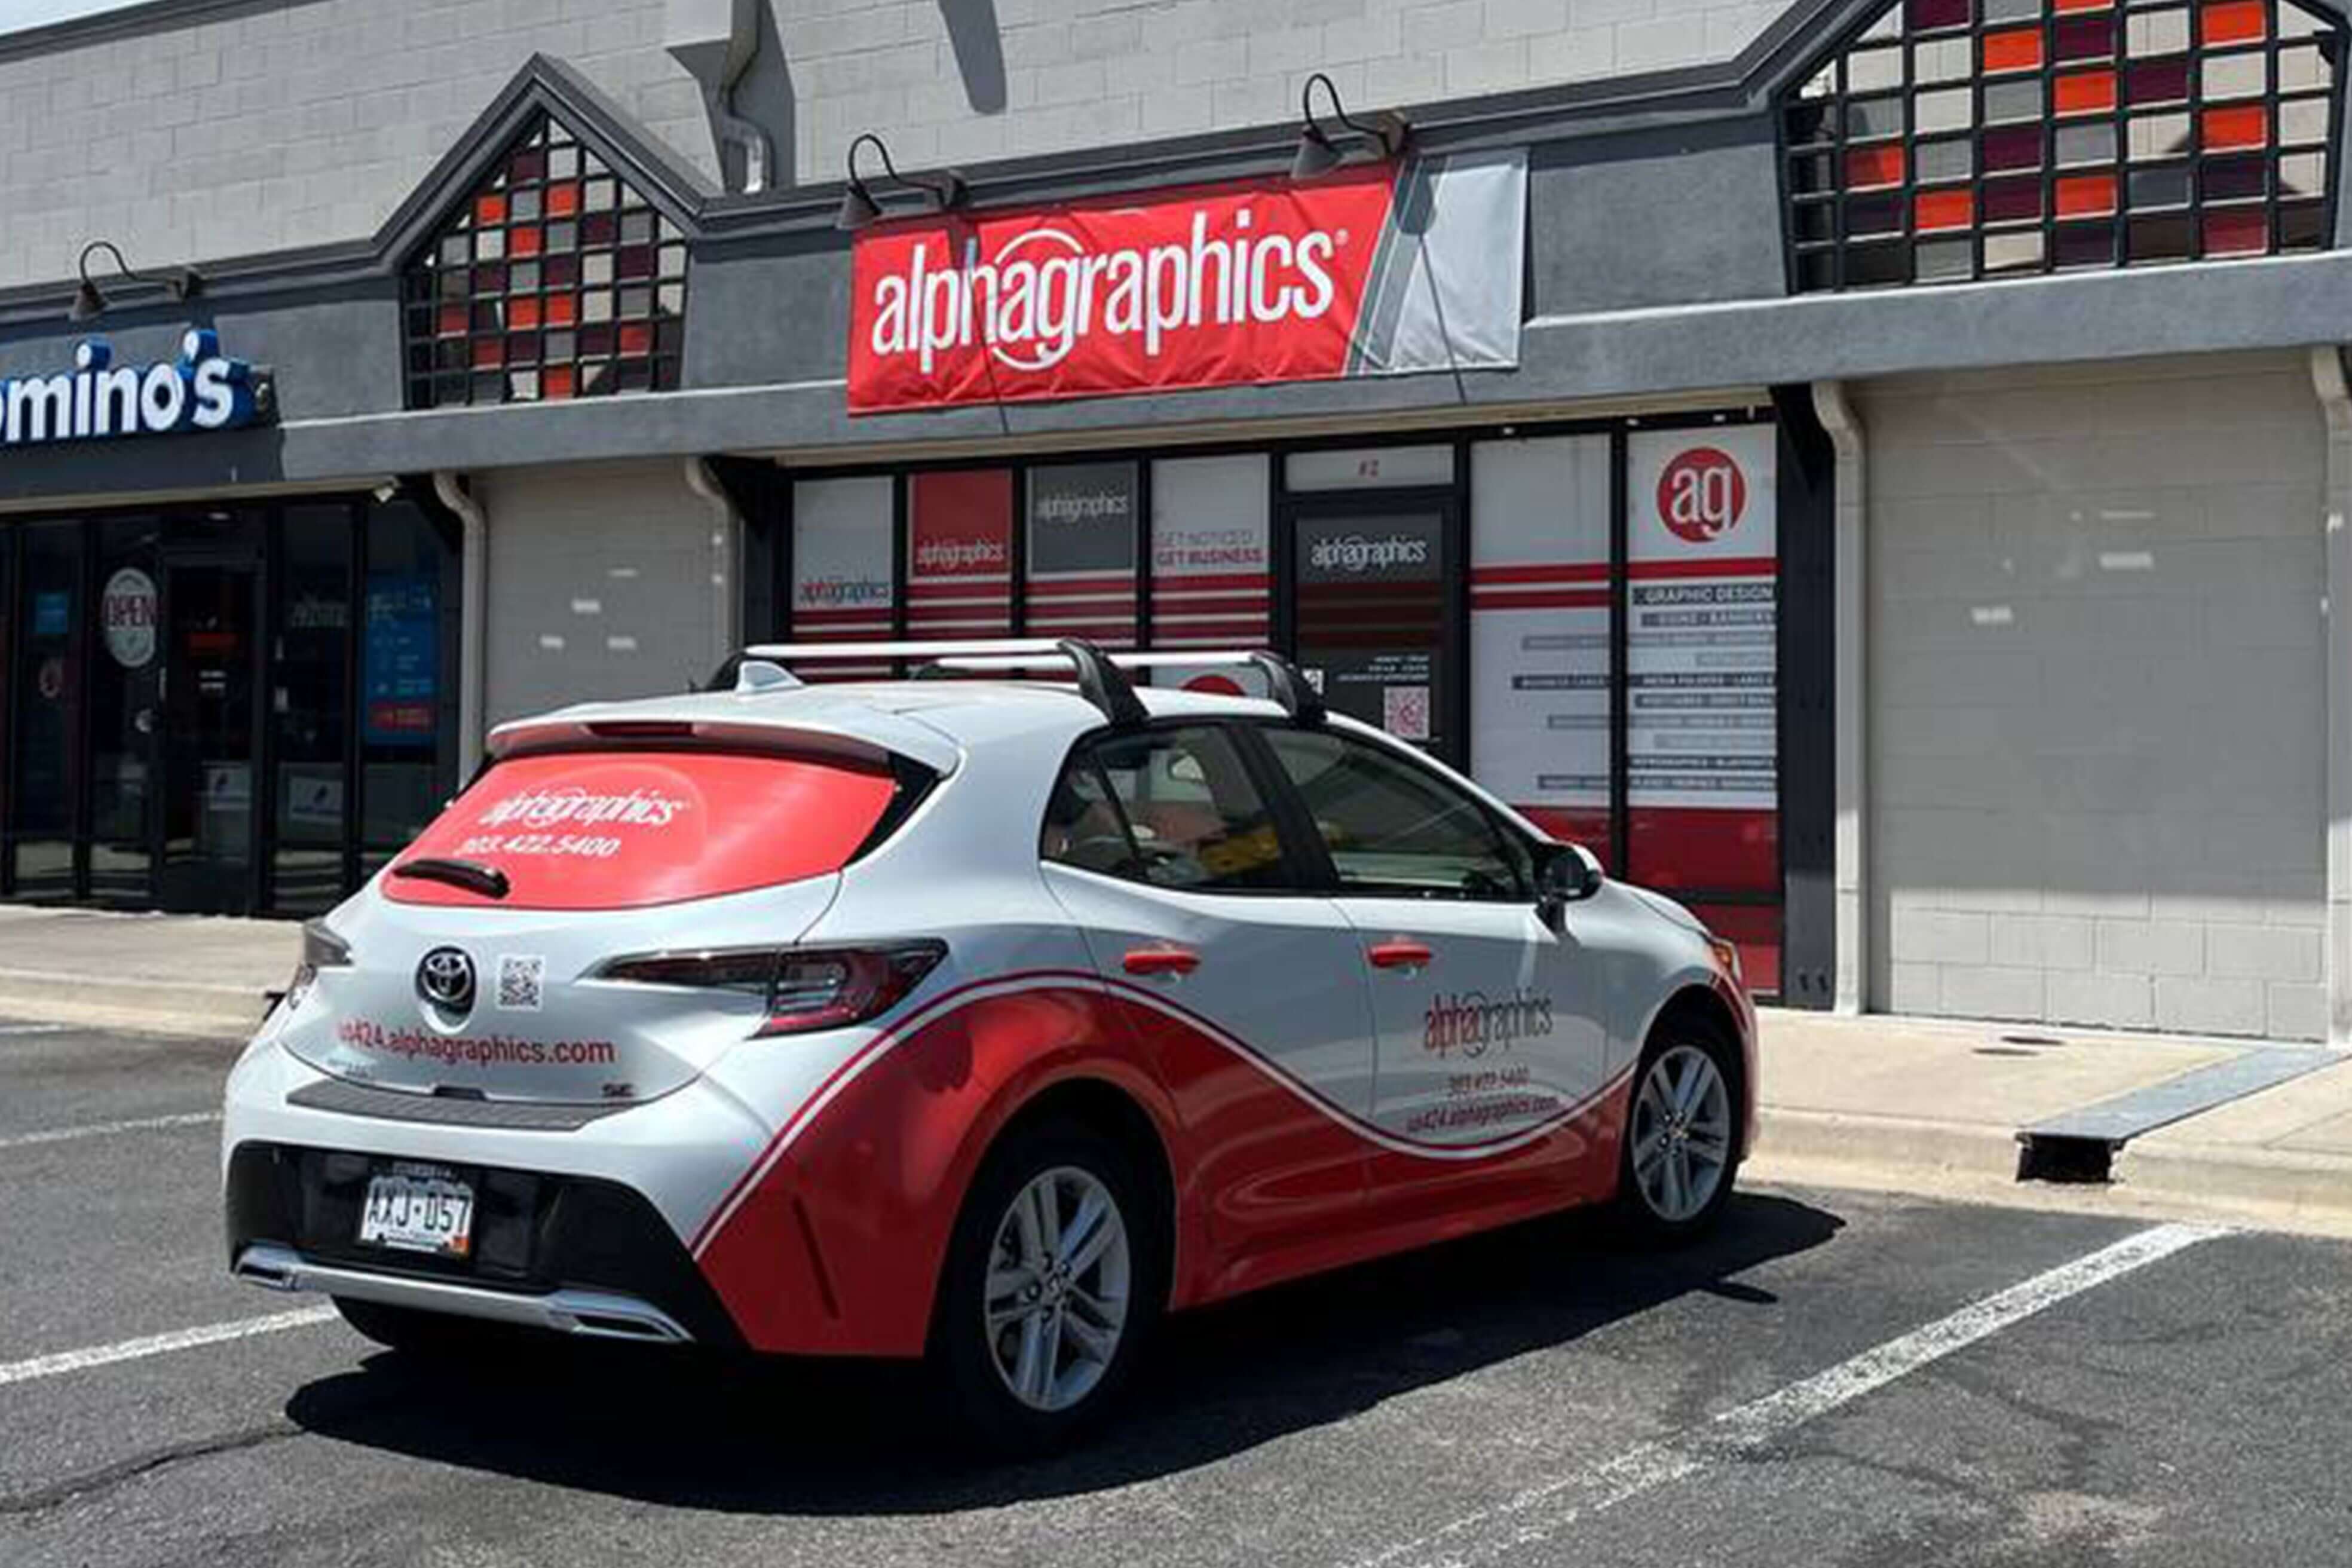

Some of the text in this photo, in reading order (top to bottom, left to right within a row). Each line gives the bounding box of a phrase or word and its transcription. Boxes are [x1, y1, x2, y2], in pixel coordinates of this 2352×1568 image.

[872, 209, 1334, 374] alphagraphics
[0, 330, 233, 442] mino's
[1671, 466, 1733, 538] ag
[1311, 535, 1428, 570] alphagraphics
